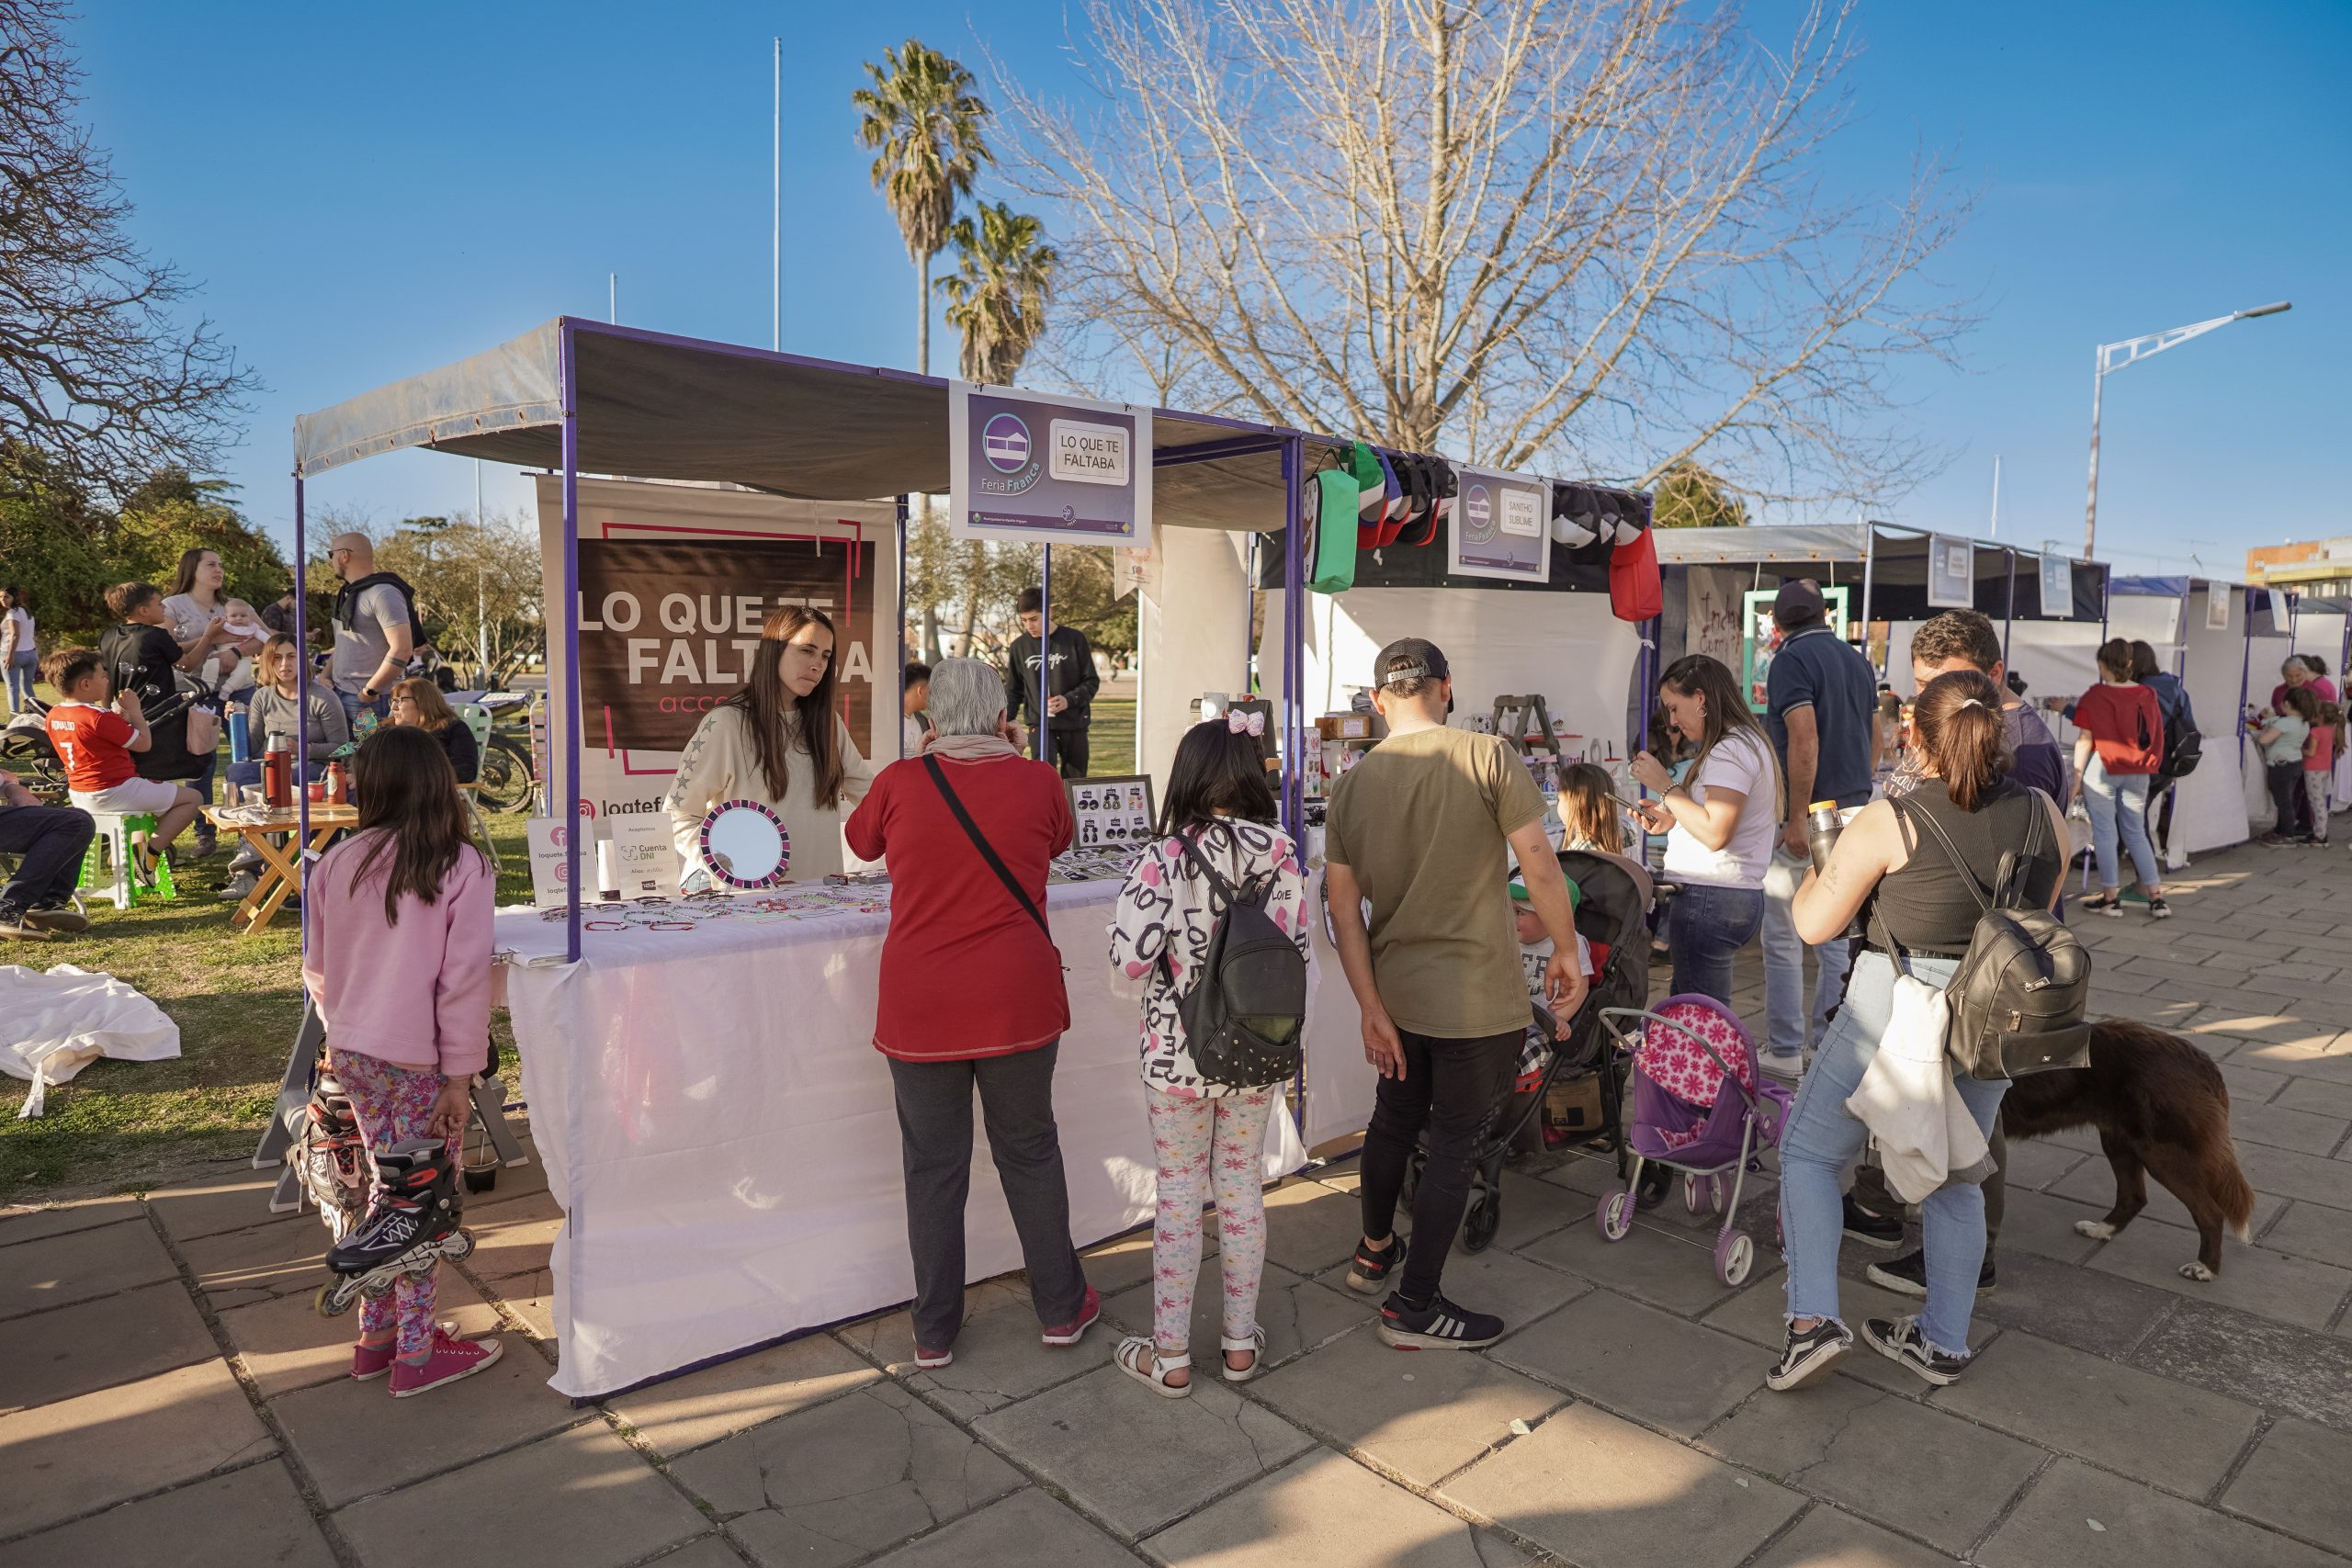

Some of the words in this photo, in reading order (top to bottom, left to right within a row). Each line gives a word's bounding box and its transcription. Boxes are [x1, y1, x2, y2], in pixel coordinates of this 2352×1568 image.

[1061, 434, 1077, 449] LO
[1080, 437, 1103, 451] QUE
[1105, 440, 1119, 453] TE
[1064, 453, 1115, 470] FALTABA
[981, 478, 1005, 491] Feria
[1006, 462, 1040, 491] Franca
[1509, 501, 1533, 513] SANTHO
[1509, 514, 1533, 526] SUBLIME
[578, 591, 641, 633] LO
[659, 592, 764, 636] QUE
[51, 720, 74, 731] RONALDO
[59, 741, 74, 771] 7
[639, 844, 668, 853] Cuenta
[639, 852, 655, 861] DNI
